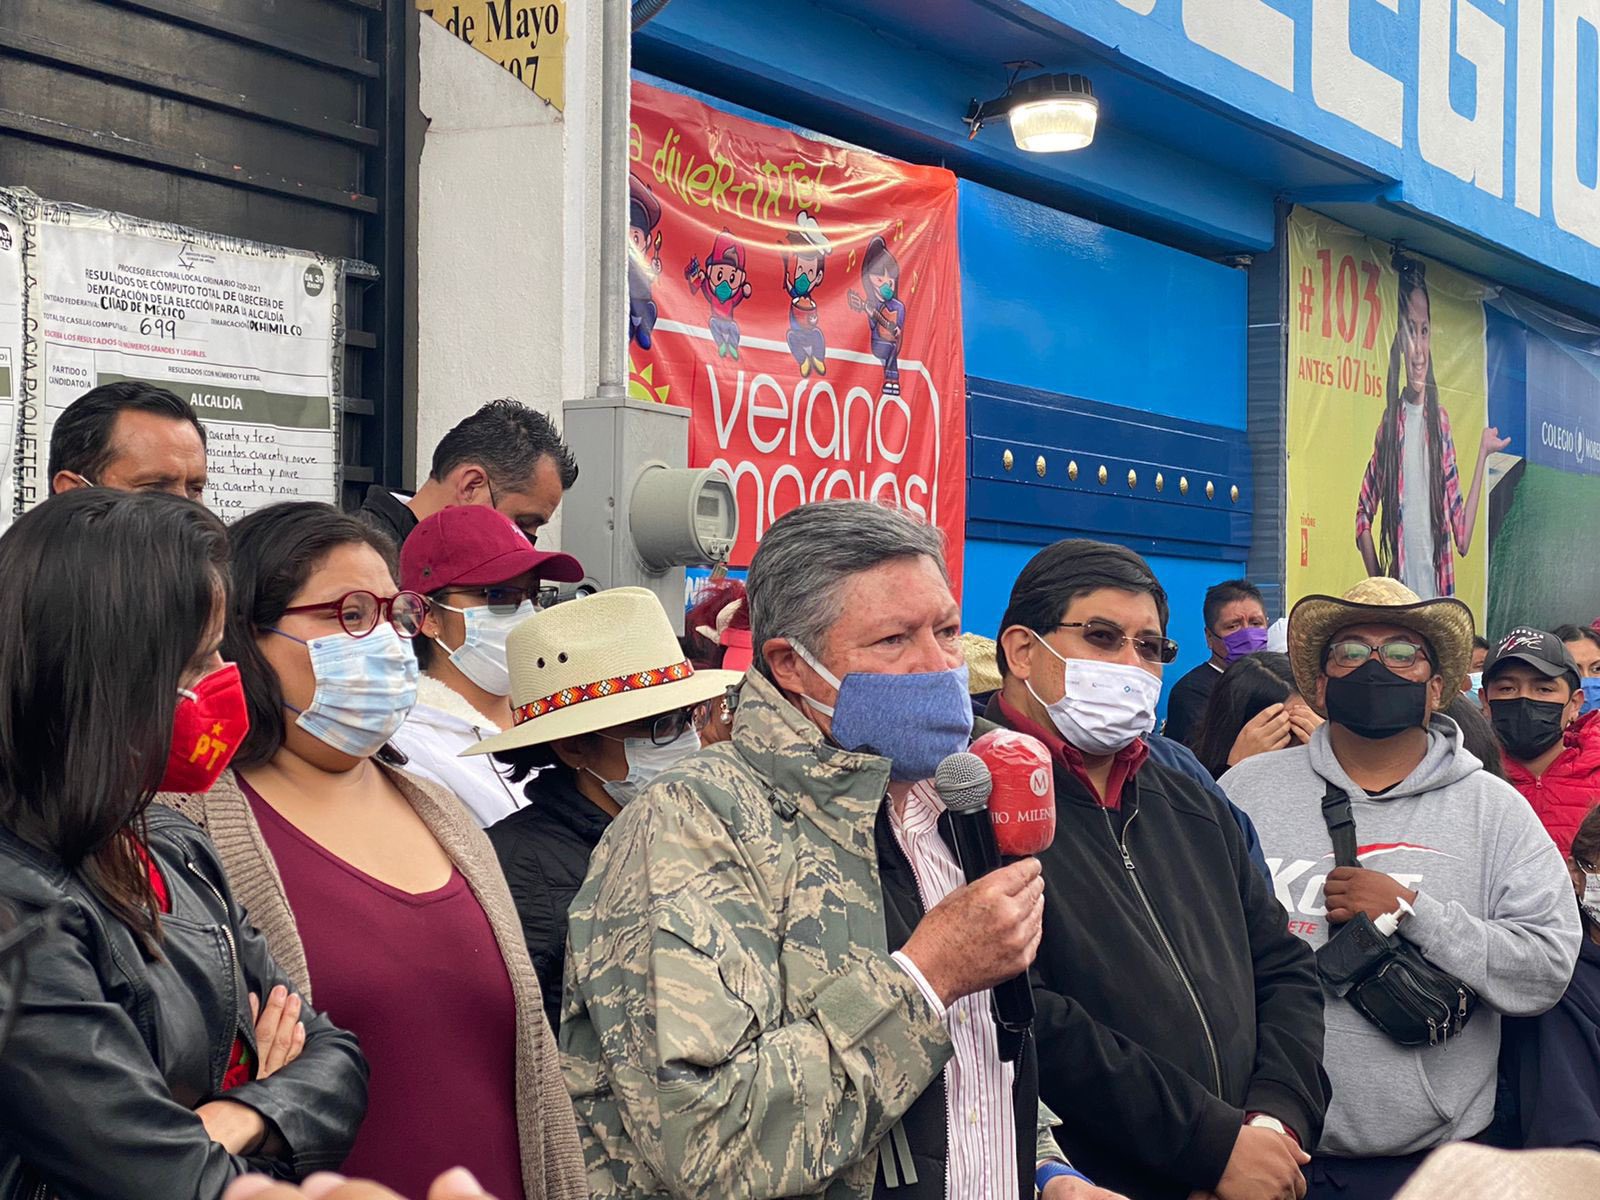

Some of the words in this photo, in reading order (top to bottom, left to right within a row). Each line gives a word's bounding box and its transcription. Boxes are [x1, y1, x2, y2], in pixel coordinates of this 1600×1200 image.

[486, 0, 559, 49] Mayo
[222, 290, 237, 301] DE
[140, 317, 176, 340] 699
[52, 364, 81, 376] PARTIDO
[1298, 356, 1334, 387] ANTES
[1337, 356, 1361, 393] 107
[1364, 360, 1383, 399] bis
[190, 392, 243, 411] ALCALDÍA
[1541, 420, 1574, 453] COLEGIO
[189, 732, 228, 771] PT
